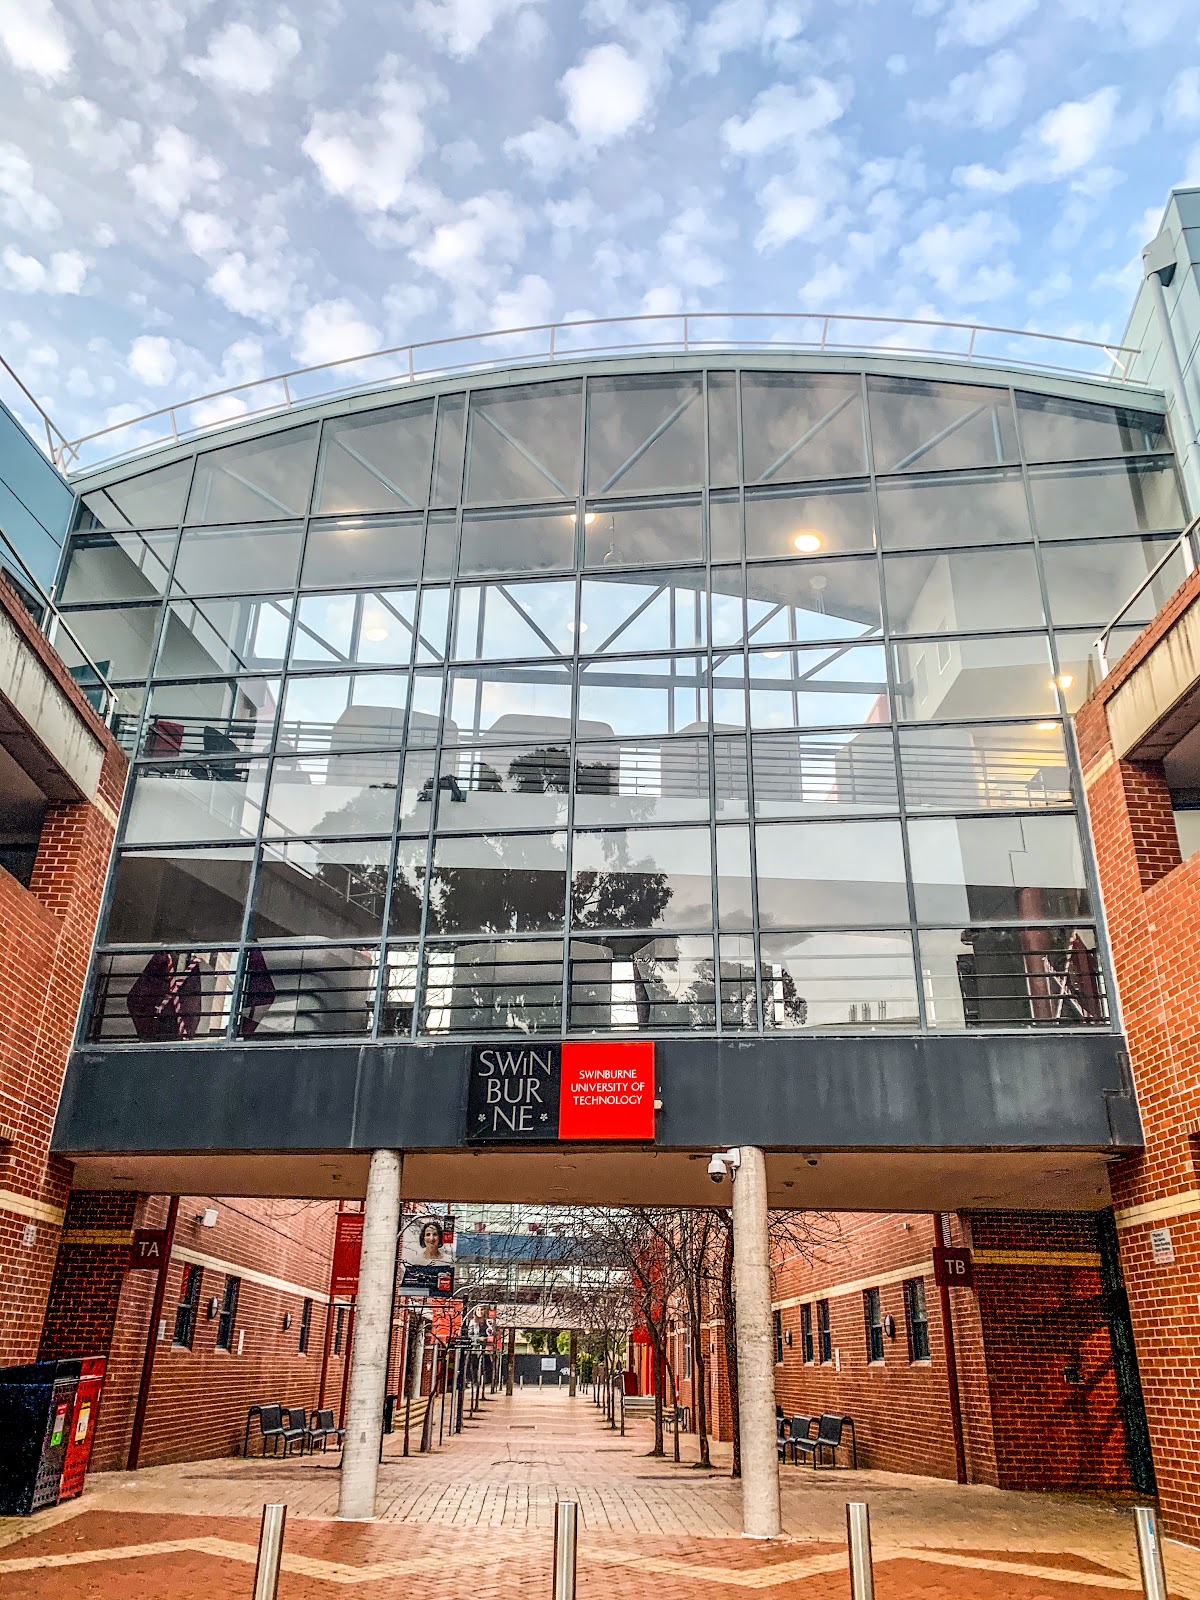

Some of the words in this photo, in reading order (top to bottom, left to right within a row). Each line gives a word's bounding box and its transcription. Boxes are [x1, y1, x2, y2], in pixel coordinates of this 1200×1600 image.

[579, 1069, 637, 1079] SWINBURNE
[486, 1078, 543, 1104] BUR
[571, 1082, 628, 1092] UNIVERSITY
[631, 1082, 645, 1092] OF
[573, 1095, 643, 1105] TECHNOLOGY
[493, 1106, 534, 1131] NE
[139, 1241, 159, 1256] TA
[945, 1260, 965, 1274] TB
